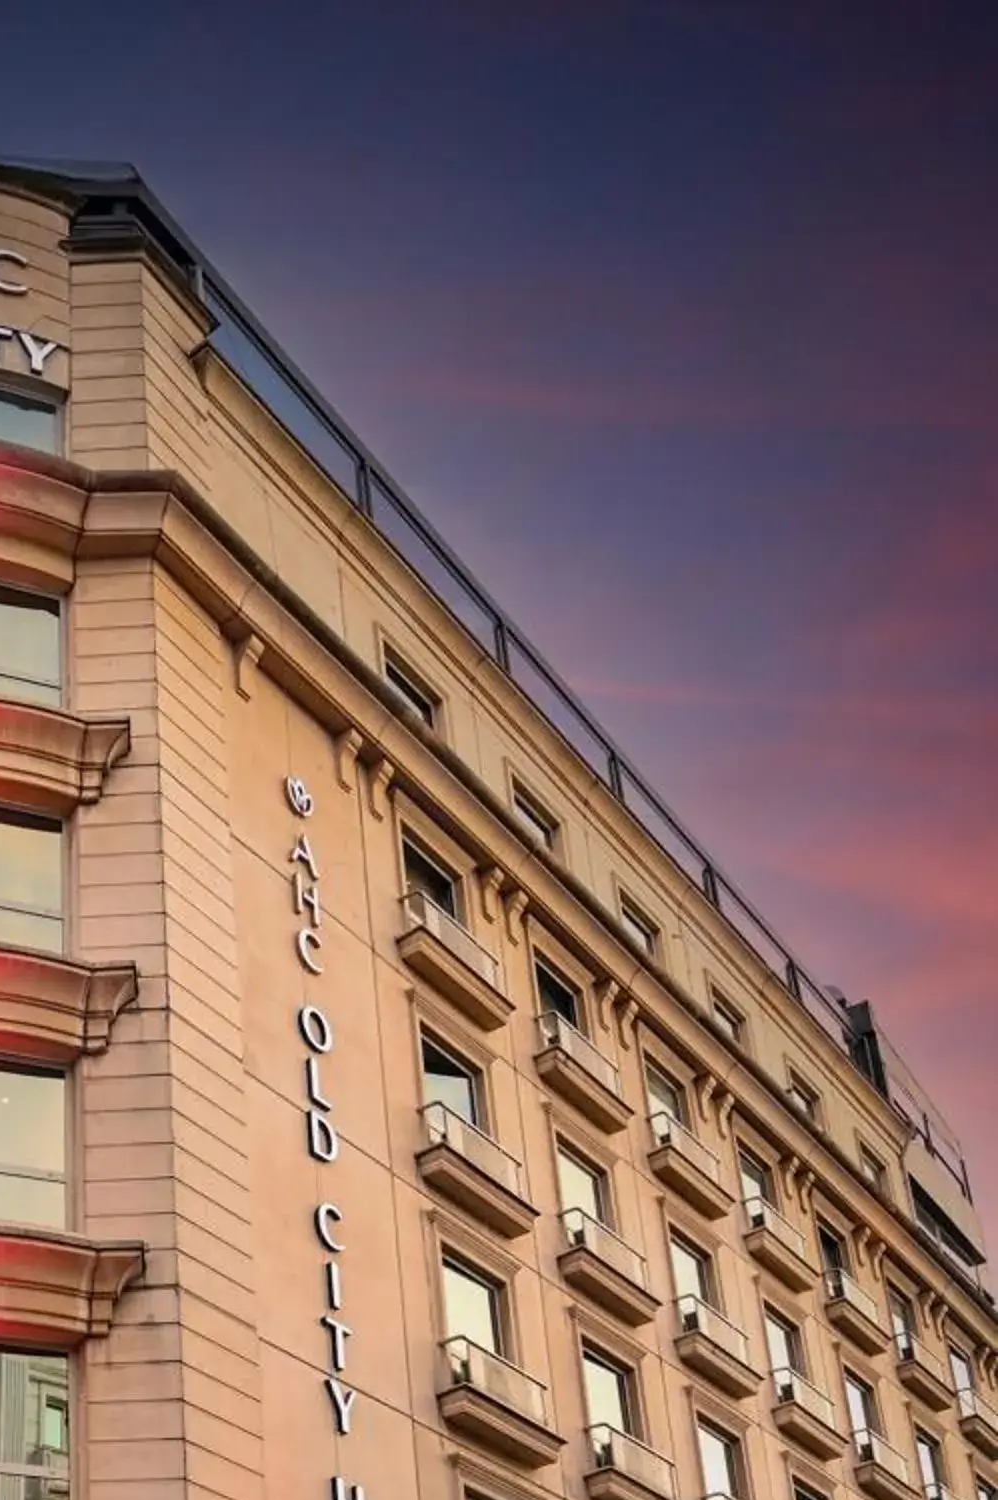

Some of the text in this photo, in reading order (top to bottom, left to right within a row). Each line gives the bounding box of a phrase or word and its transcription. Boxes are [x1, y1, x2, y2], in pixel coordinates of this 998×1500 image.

[291, 834, 323, 975] AHC
[299, 1005, 338, 1163] OLD
[315, 1203, 356, 1436] CITY
